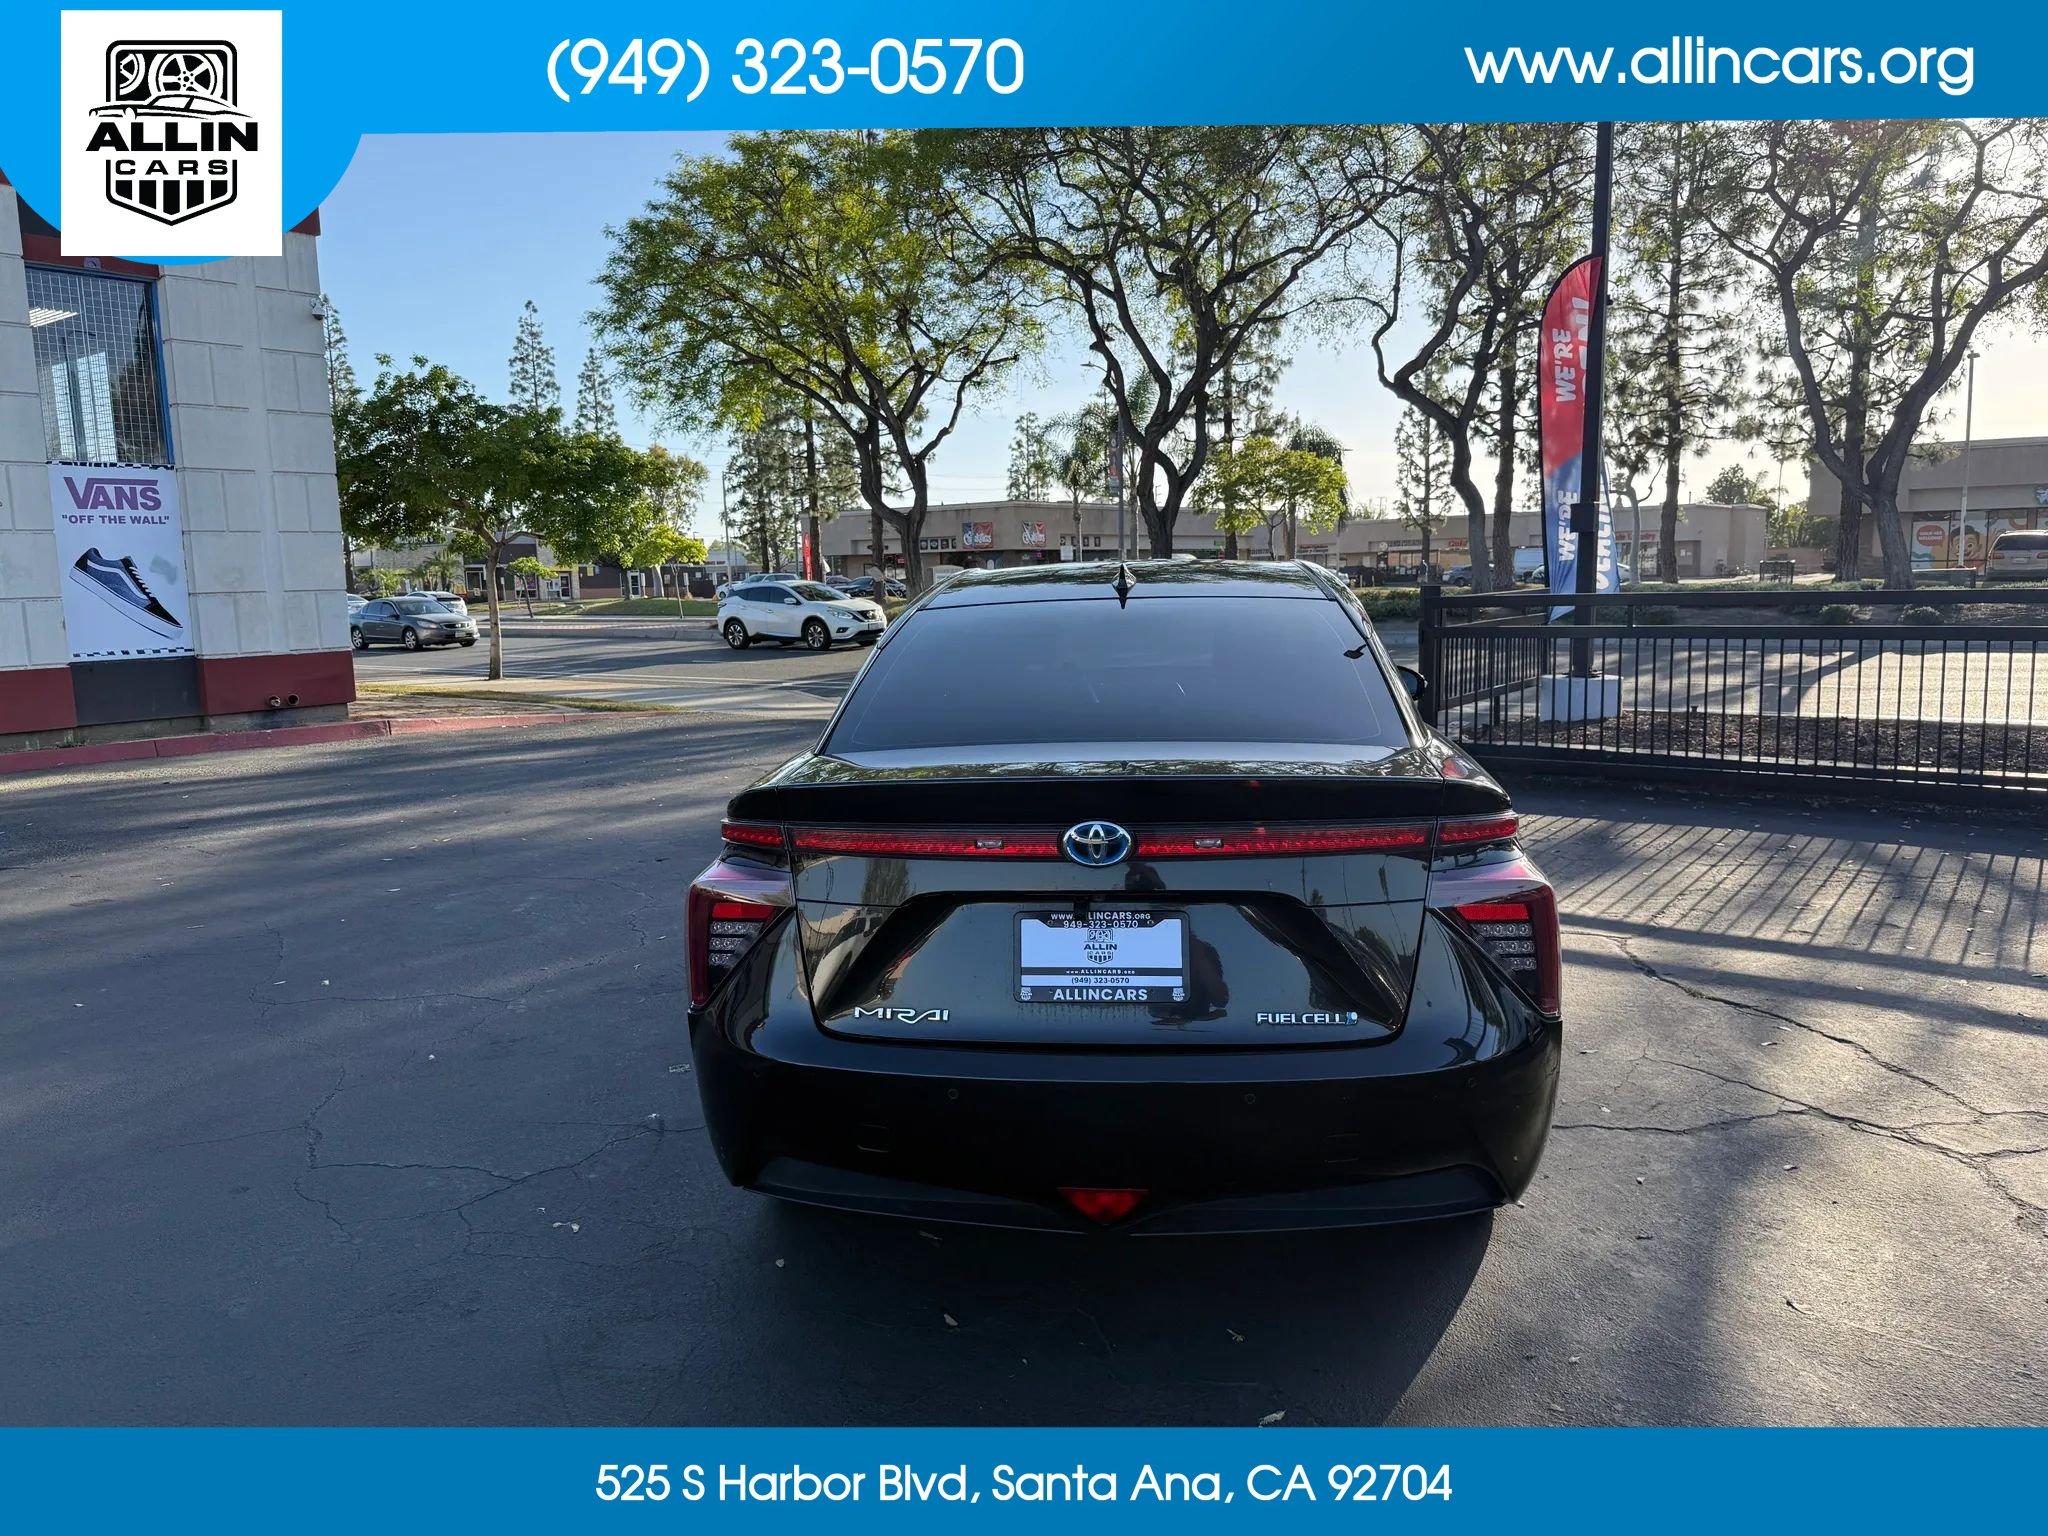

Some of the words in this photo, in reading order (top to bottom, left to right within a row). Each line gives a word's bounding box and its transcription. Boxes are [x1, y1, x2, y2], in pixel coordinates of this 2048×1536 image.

[1552, 328, 1577, 402] WE'RE
[63, 477, 162, 511] VANS
[62, 514, 95, 524] "OFF
[99, 515, 126, 524] THE
[131, 515, 170, 525] WALL"
[1063, 920, 1138, 928] 949-323-0570
[1083, 943, 1118, 951] ALLIN
[1071, 977, 1091, 985] (949)
[1053, 988, 1148, 1001] ALLINCARS
[854, 1006, 949, 1024] MIRAI
